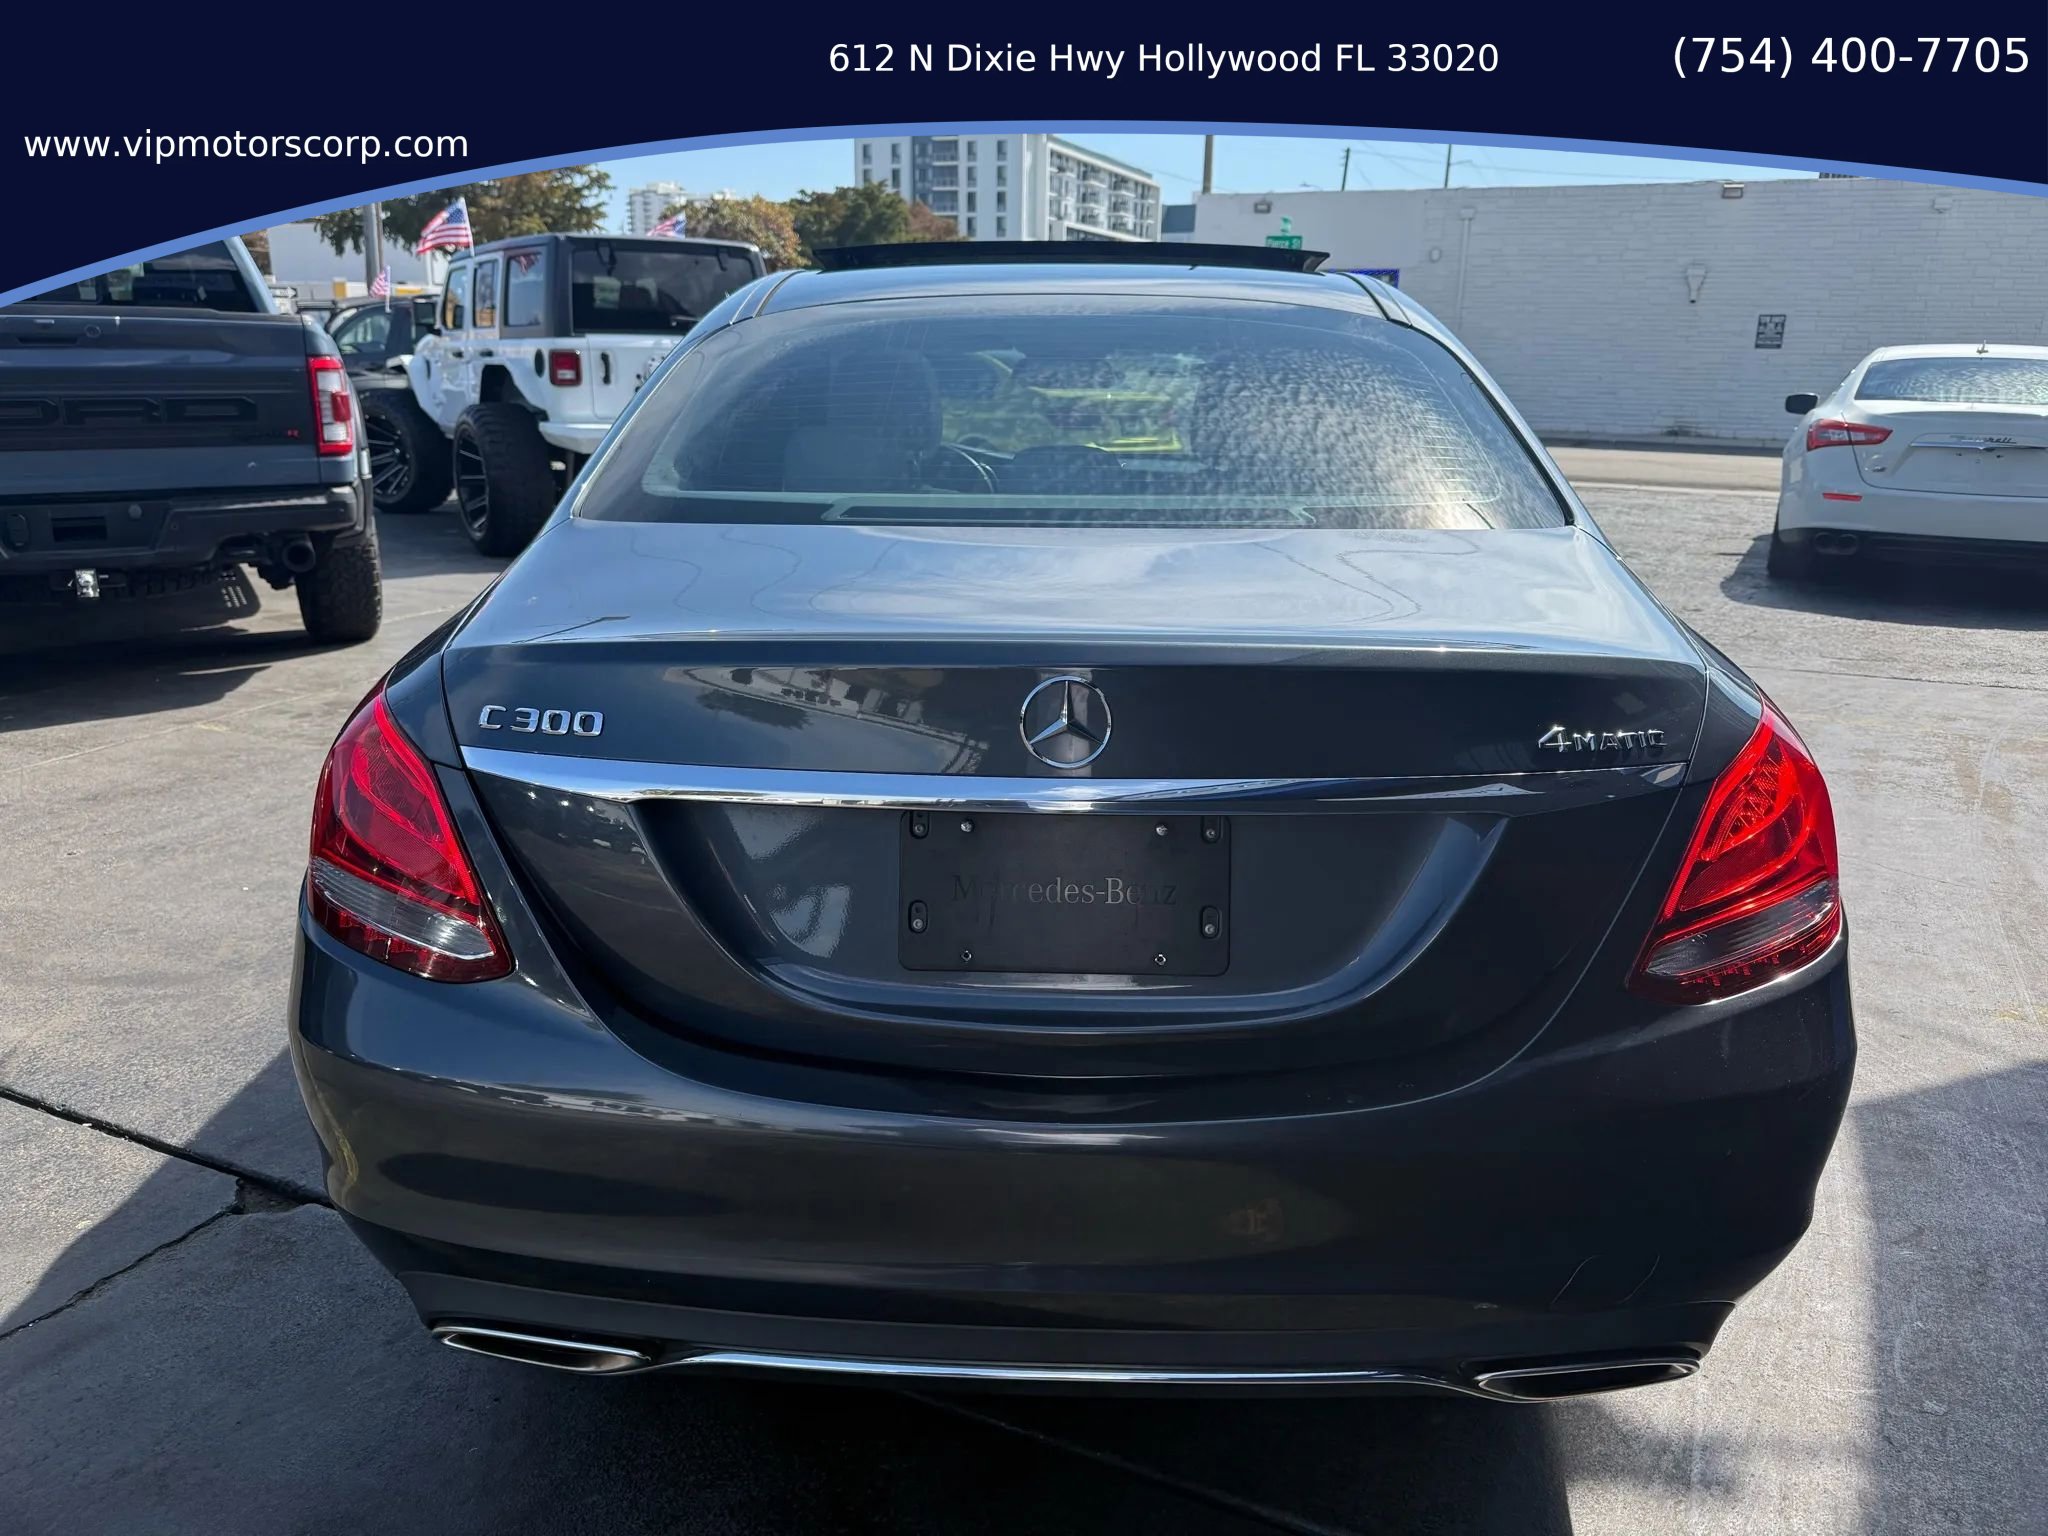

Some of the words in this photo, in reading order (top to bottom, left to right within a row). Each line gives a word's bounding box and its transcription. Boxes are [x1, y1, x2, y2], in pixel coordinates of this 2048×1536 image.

[479, 704, 507, 730] C
[510, 707, 604, 736] 300
[1538, 724, 1668, 753] 4MATIC
[952, 875, 1177, 905] Mercedes-Benz
